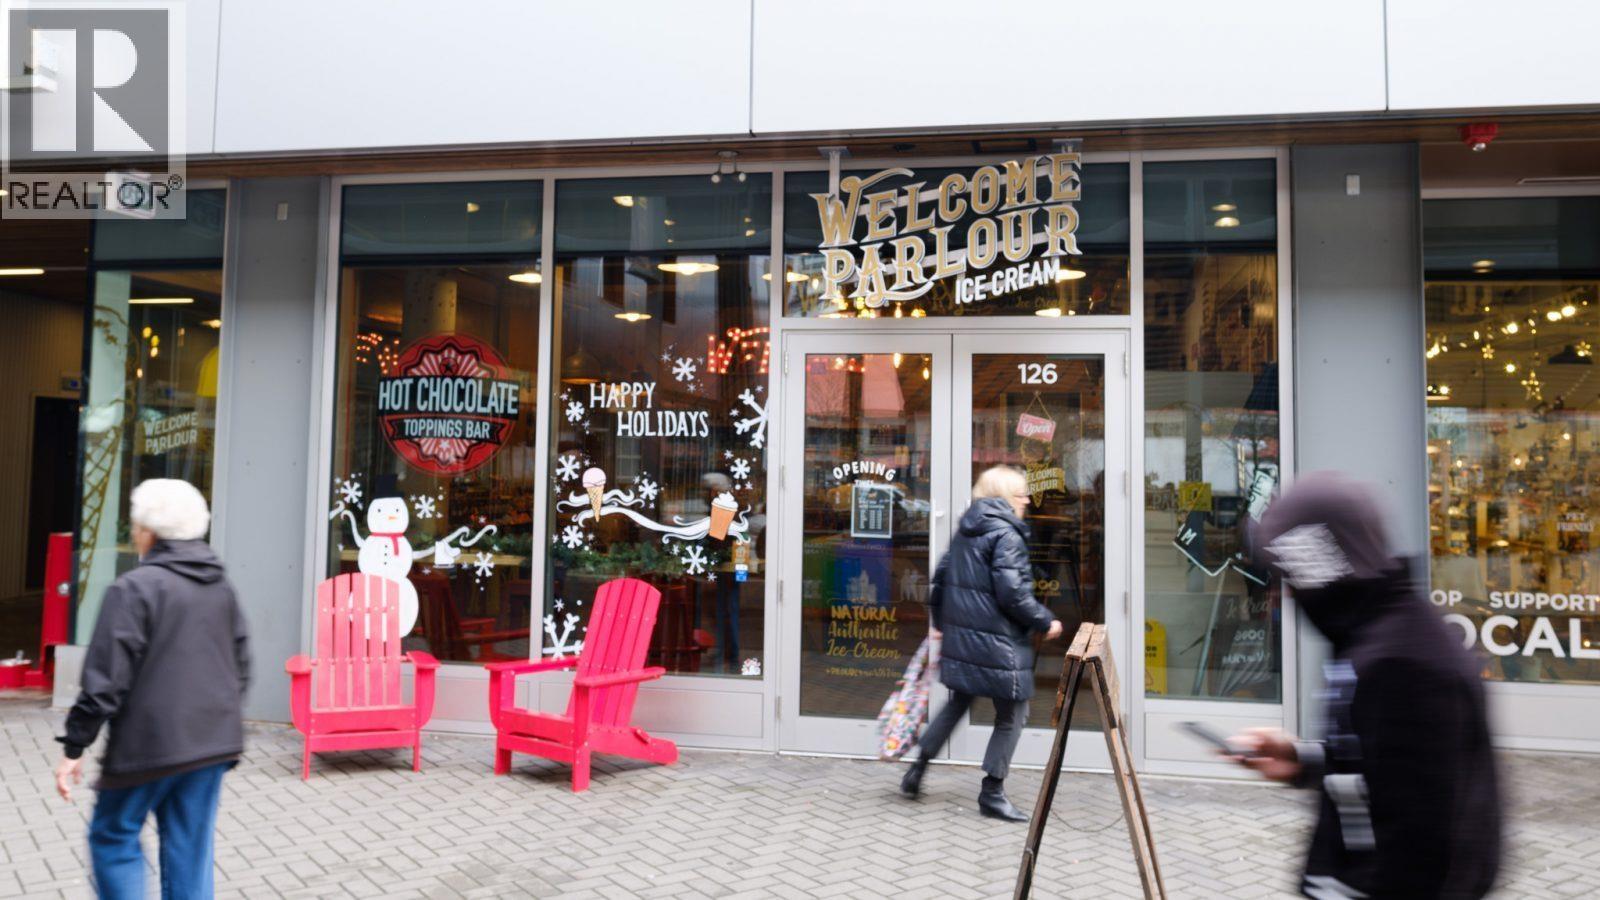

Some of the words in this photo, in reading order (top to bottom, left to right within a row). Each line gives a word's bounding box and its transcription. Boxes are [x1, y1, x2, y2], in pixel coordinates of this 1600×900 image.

[808, 152, 1083, 248] WELCOME
[818, 204, 1083, 308] PARLOUR
[955, 275, 987, 305] ICE
[991, 258, 1061, 297] CREAM
[1017, 362, 1058, 385] 126
[378, 378, 414, 411] HOT
[416, 377, 519, 415] CHOCOLATE
[589, 382, 656, 409] HAPPY
[143, 411, 199, 437] WELCOME
[403, 418, 462, 438] TOPPINGS
[465, 420, 491, 439] BAR
[616, 410, 709, 438] HOLIDAYS
[1021, 421, 1051, 438] Open
[145, 428, 199, 454] PARLOUR
[832, 460, 897, 481] OPENING
[1025, 467, 1058, 483] ELCOME
[1025, 478, 1059, 496] ARLOUR
[1429, 589, 1464, 607] OP
[831, 604, 897, 622] NATURAL
[1442, 613, 1600, 660] OCAL
[825, 638, 849, 657] Ice
[852, 641, 903, 660] Cream
